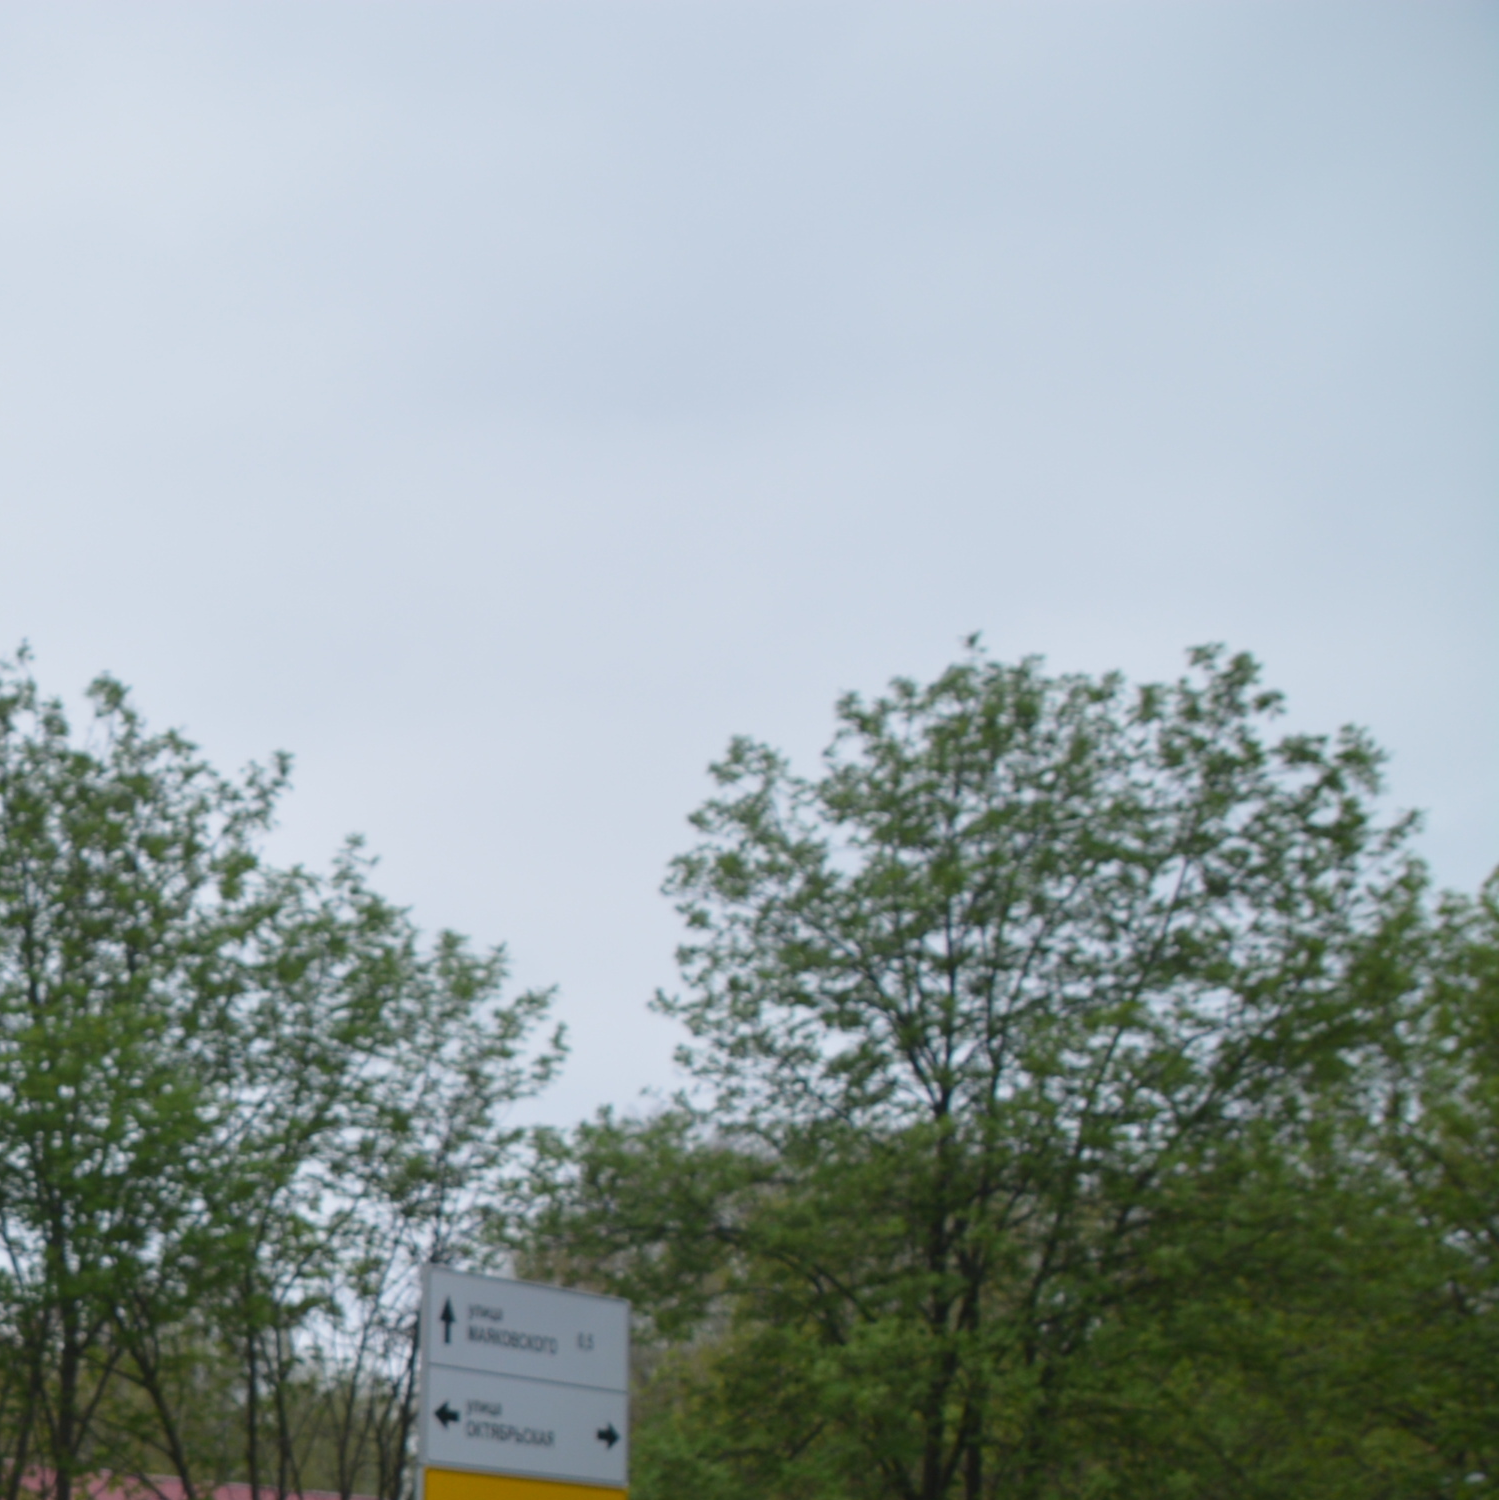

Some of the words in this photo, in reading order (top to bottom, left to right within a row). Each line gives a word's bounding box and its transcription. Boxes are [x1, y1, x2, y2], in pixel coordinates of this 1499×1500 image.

[468, 1304, 504, 1321] улица
[467, 1325, 559, 1355] МАЯКОВСКОГО
[466, 1399, 503, 1416] улица
[465, 1419, 555, 1446] ОКТЯБРЬСКАЯ
